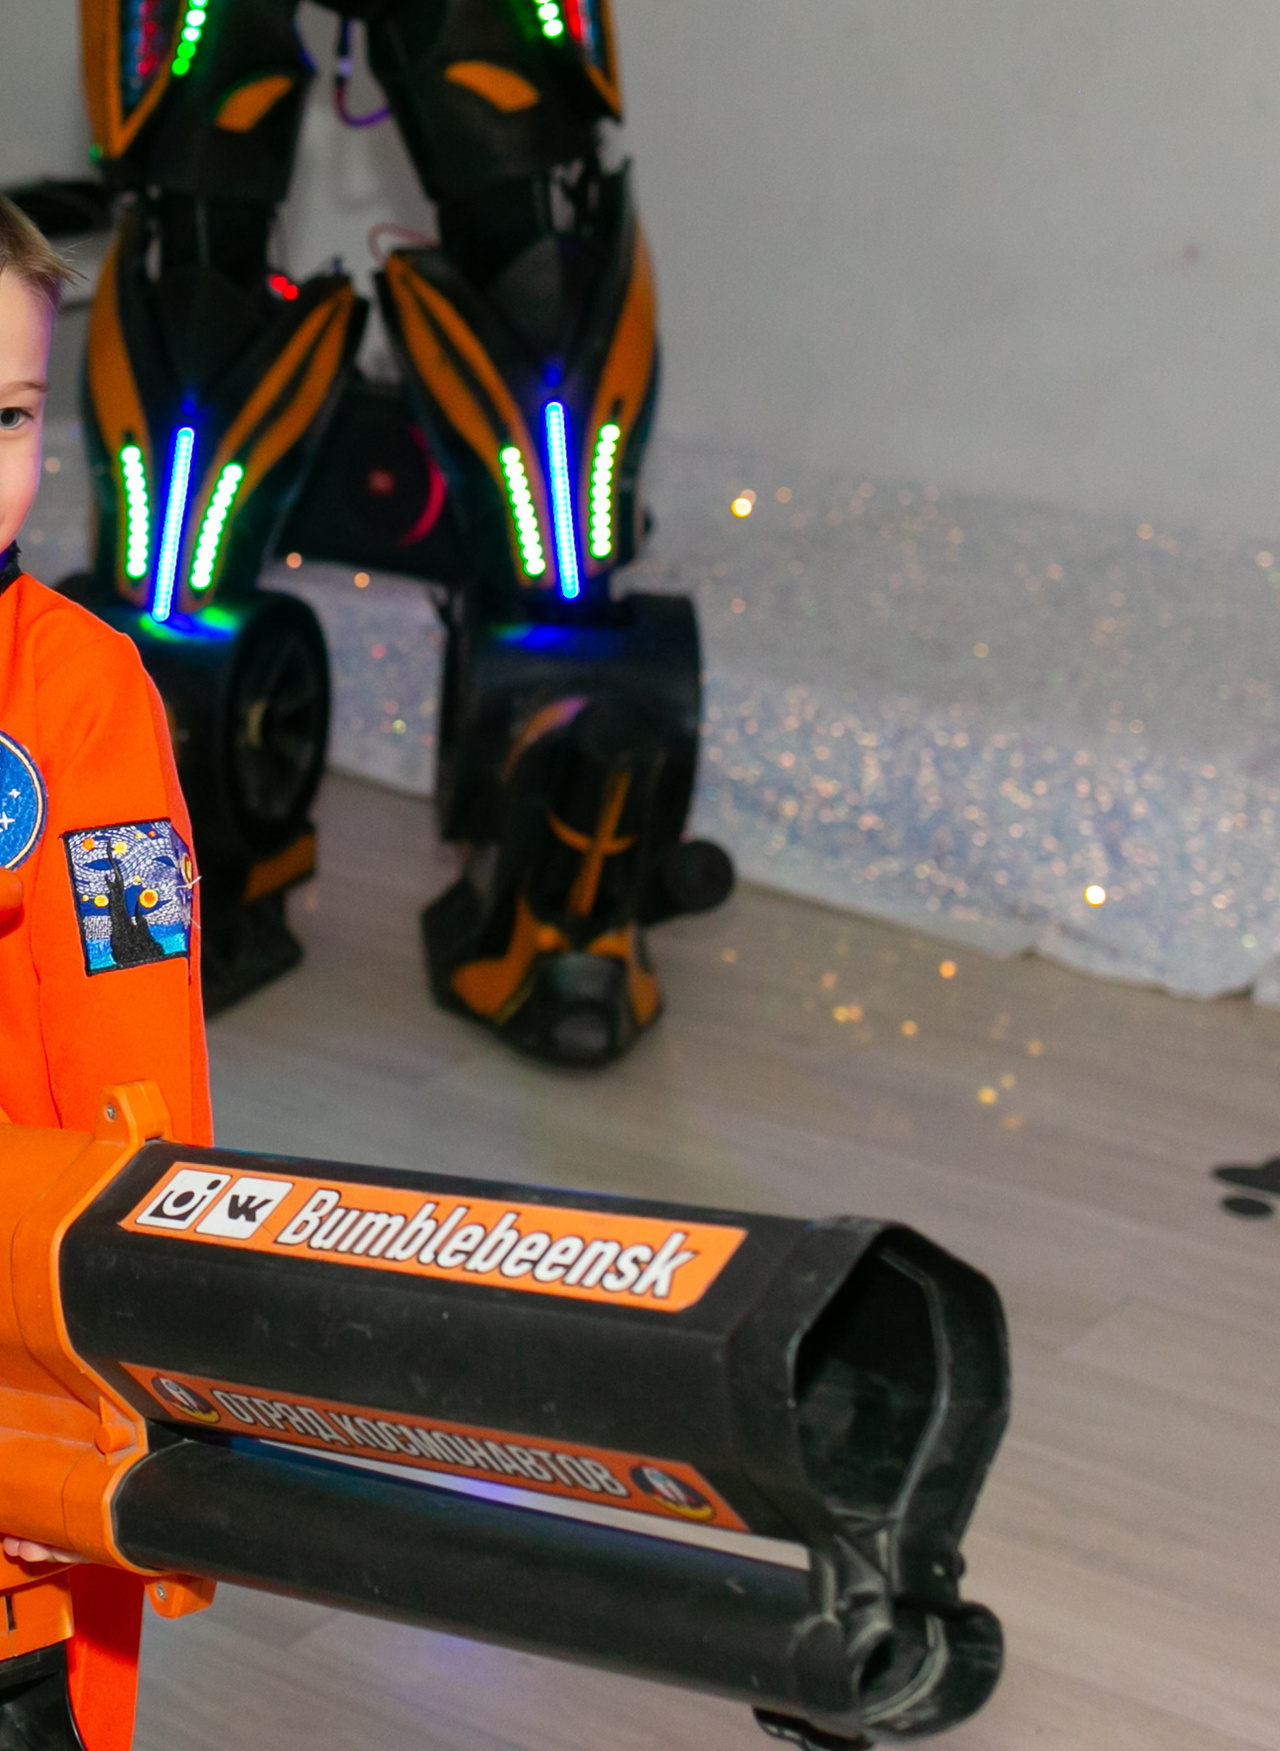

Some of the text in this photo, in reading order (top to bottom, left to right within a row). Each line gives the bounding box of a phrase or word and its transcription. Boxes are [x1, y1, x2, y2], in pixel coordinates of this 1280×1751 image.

[276, 1188, 701, 1300] Bumblebeensk
[211, 1389, 629, 1498] ОТРЯД КОСМОНАВТОВ
